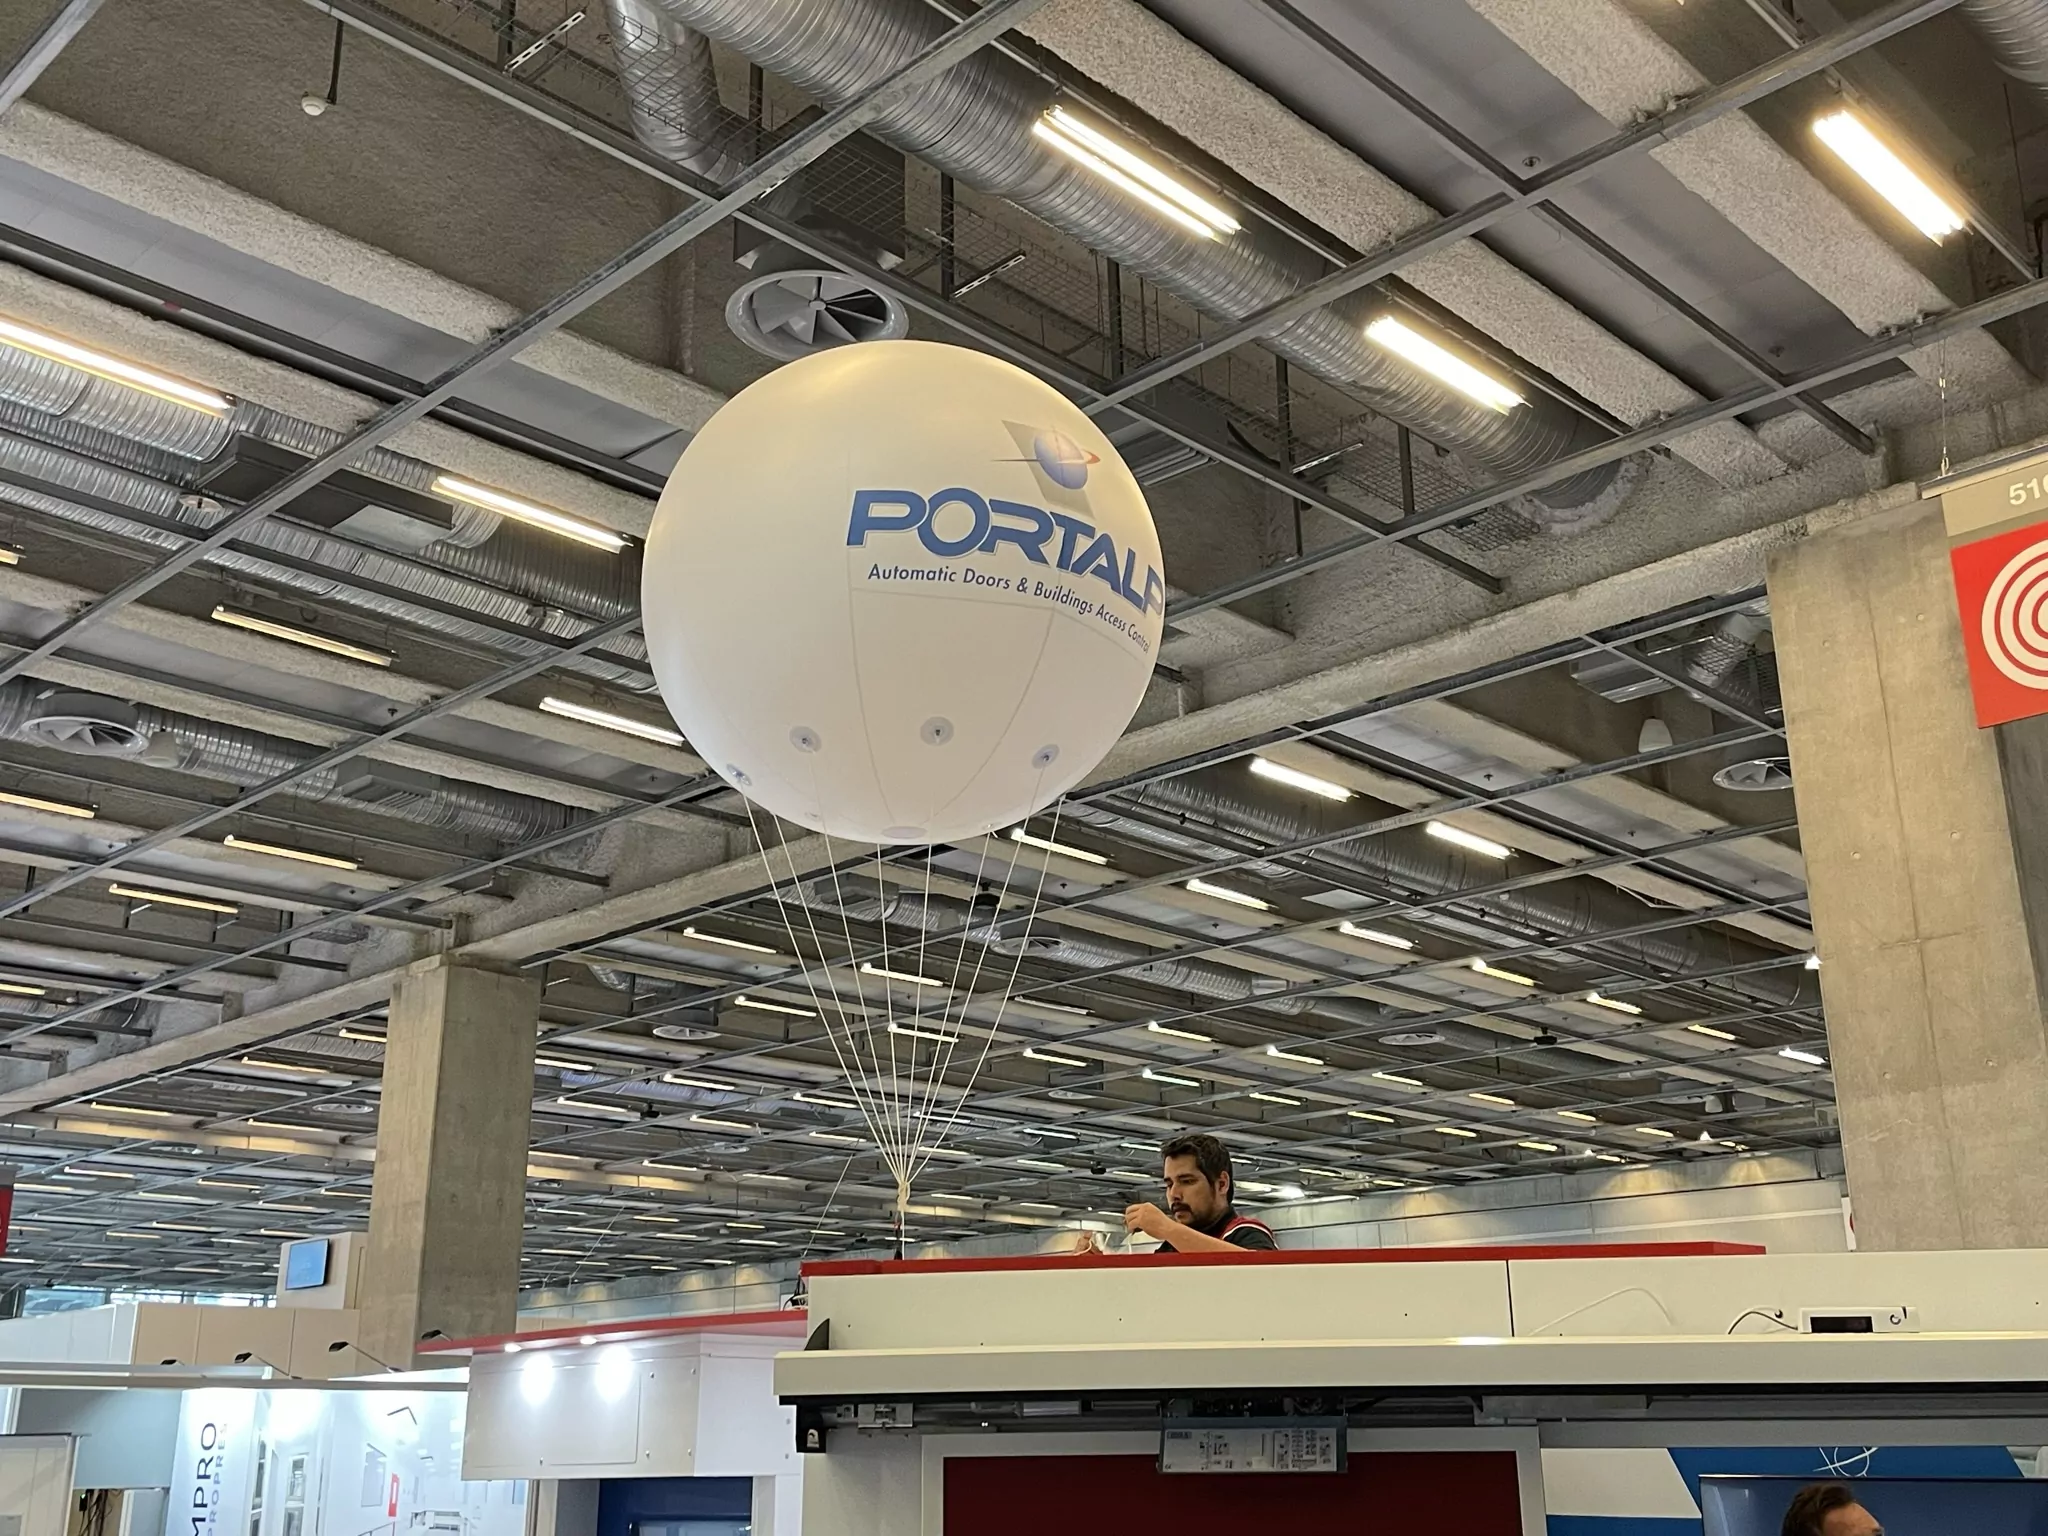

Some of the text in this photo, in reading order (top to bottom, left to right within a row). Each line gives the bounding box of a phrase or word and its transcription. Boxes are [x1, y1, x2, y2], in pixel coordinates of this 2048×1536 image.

[846, 487, 1164, 616] PORTALP
[867, 563, 1152, 654] Automatic Doors & Buildings Access Control
